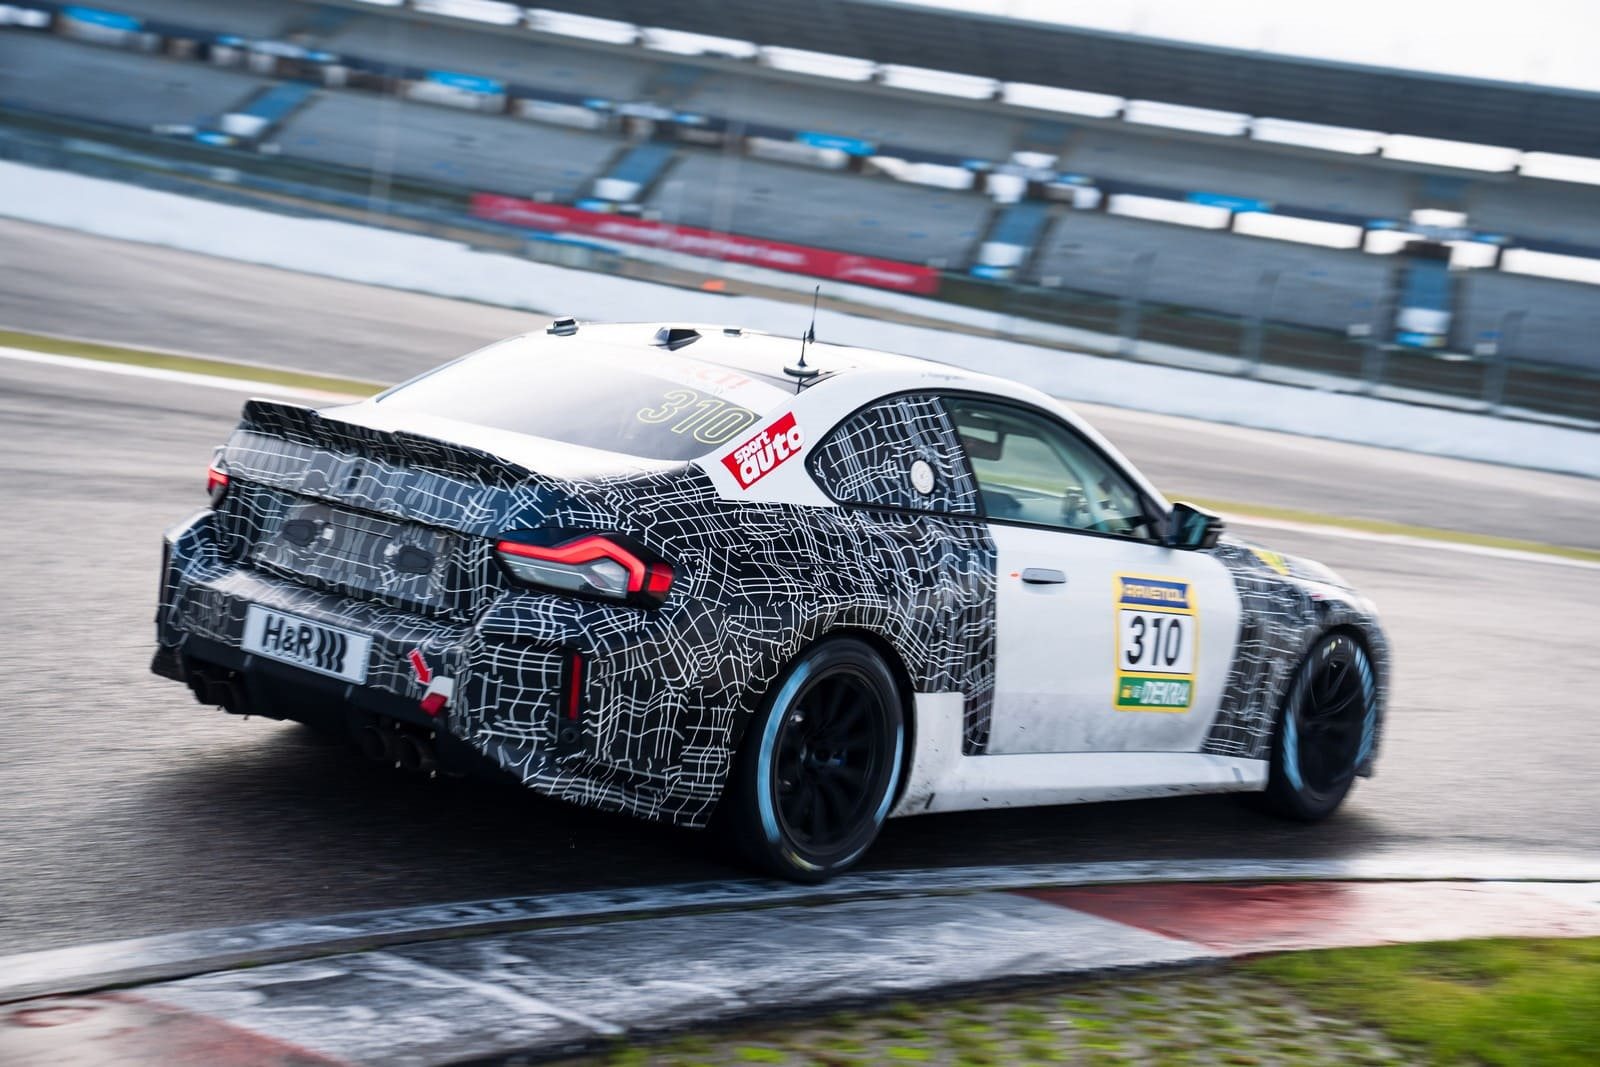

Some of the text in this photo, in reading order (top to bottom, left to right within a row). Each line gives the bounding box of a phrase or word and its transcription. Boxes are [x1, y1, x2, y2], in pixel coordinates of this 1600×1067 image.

[637, 389, 755, 444] 310
[733, 431, 770, 464] sport
[739, 425, 805, 485] auto
[1126, 615, 1182, 666] 310
[1139, 681, 1189, 705] DEKRA
